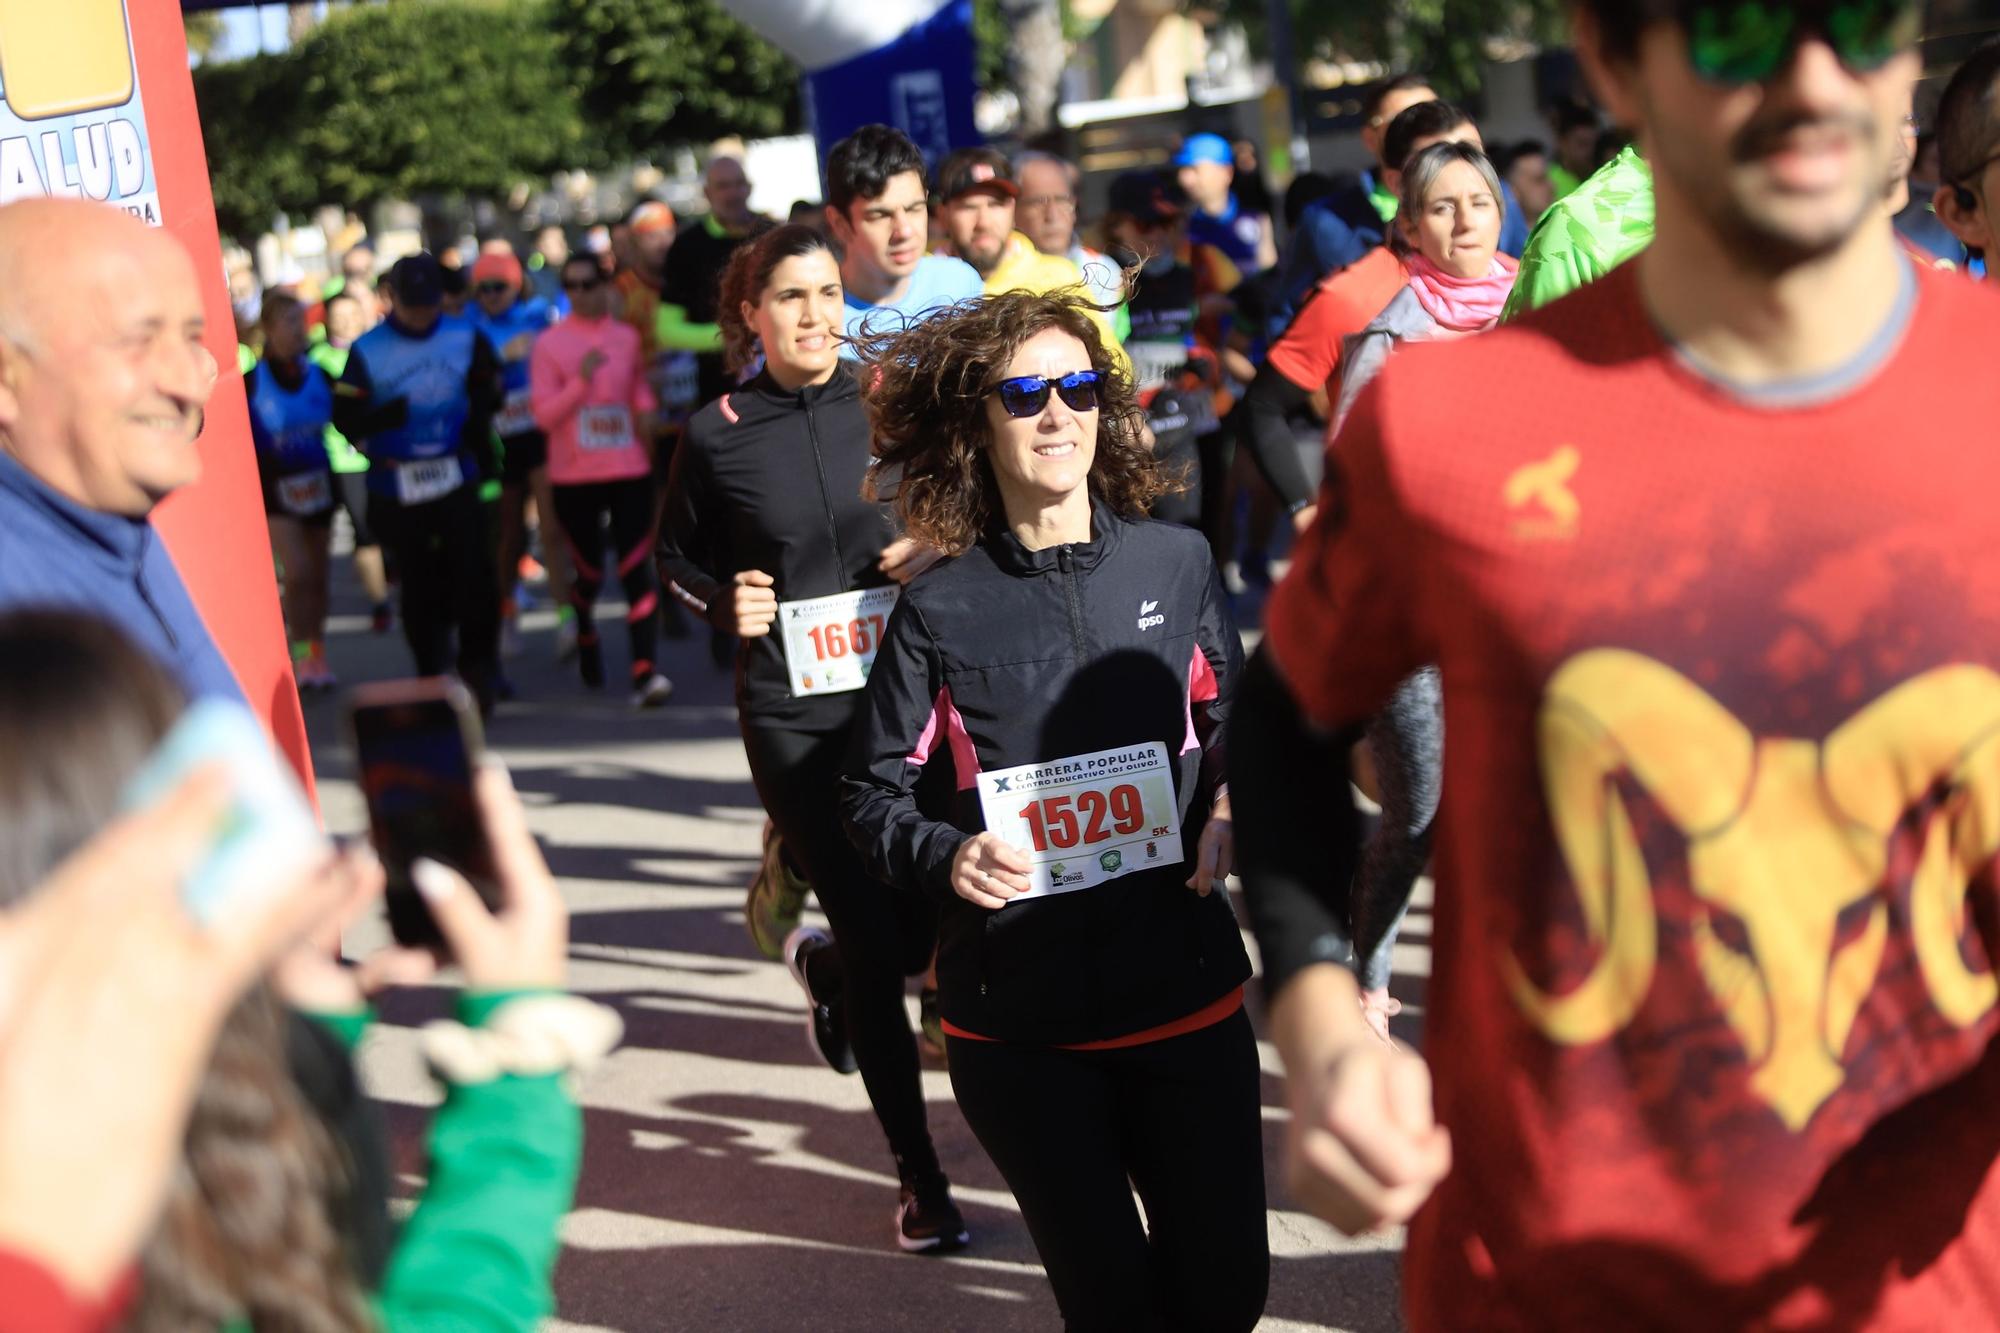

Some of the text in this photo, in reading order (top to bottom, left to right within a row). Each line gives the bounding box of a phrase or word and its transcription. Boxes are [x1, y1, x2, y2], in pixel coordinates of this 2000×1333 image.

[792, 608, 801, 618] X
[1138, 614, 1164, 631] ipso
[808, 614, 886, 662] 1667
[993, 749, 1157, 793] X CARRERA POPULAR
[1016, 759, 1158, 791] CENTRO EDUCATIVO LOS OLIVOS
[1019, 784, 1144, 852] 1529
[1153, 826, 1169, 836] 5K
